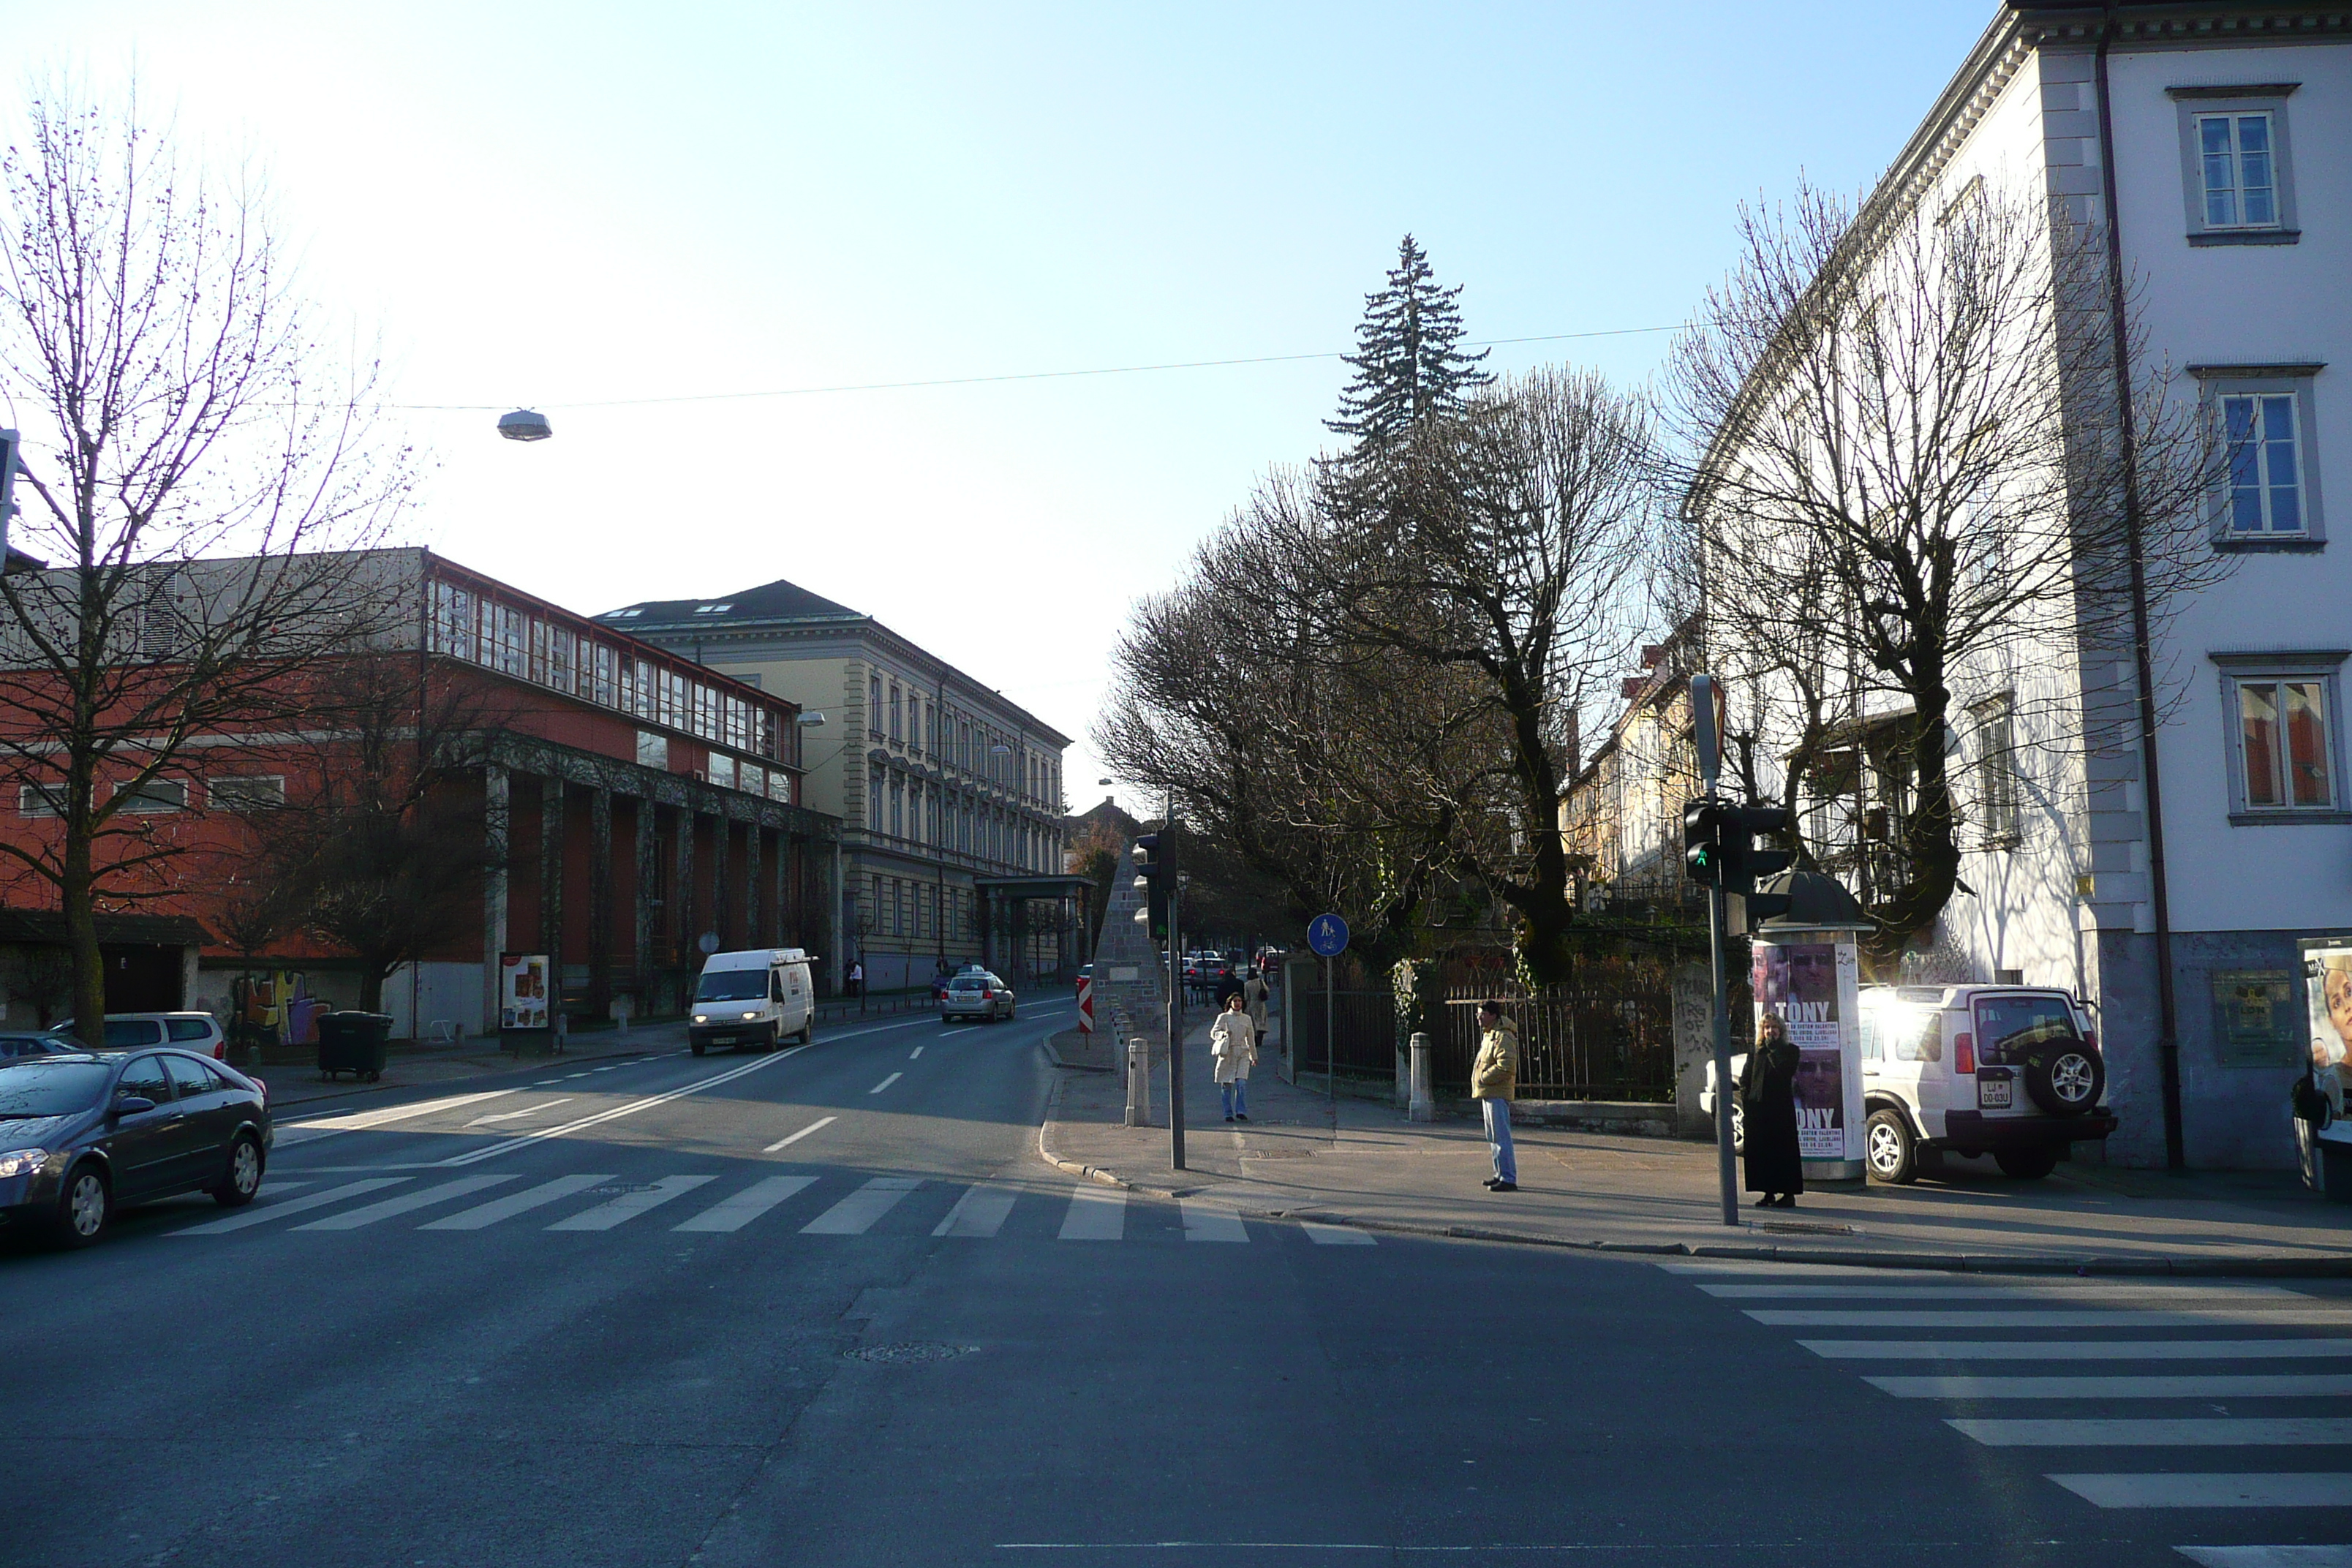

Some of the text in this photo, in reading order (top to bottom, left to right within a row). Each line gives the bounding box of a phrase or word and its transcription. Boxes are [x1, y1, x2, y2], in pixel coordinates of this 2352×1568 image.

[1775, 1002, 1830, 1022] TONY
[1987, 1083, 1997, 1092] LJ
[1795, 1107, 1834, 1129] ONY
